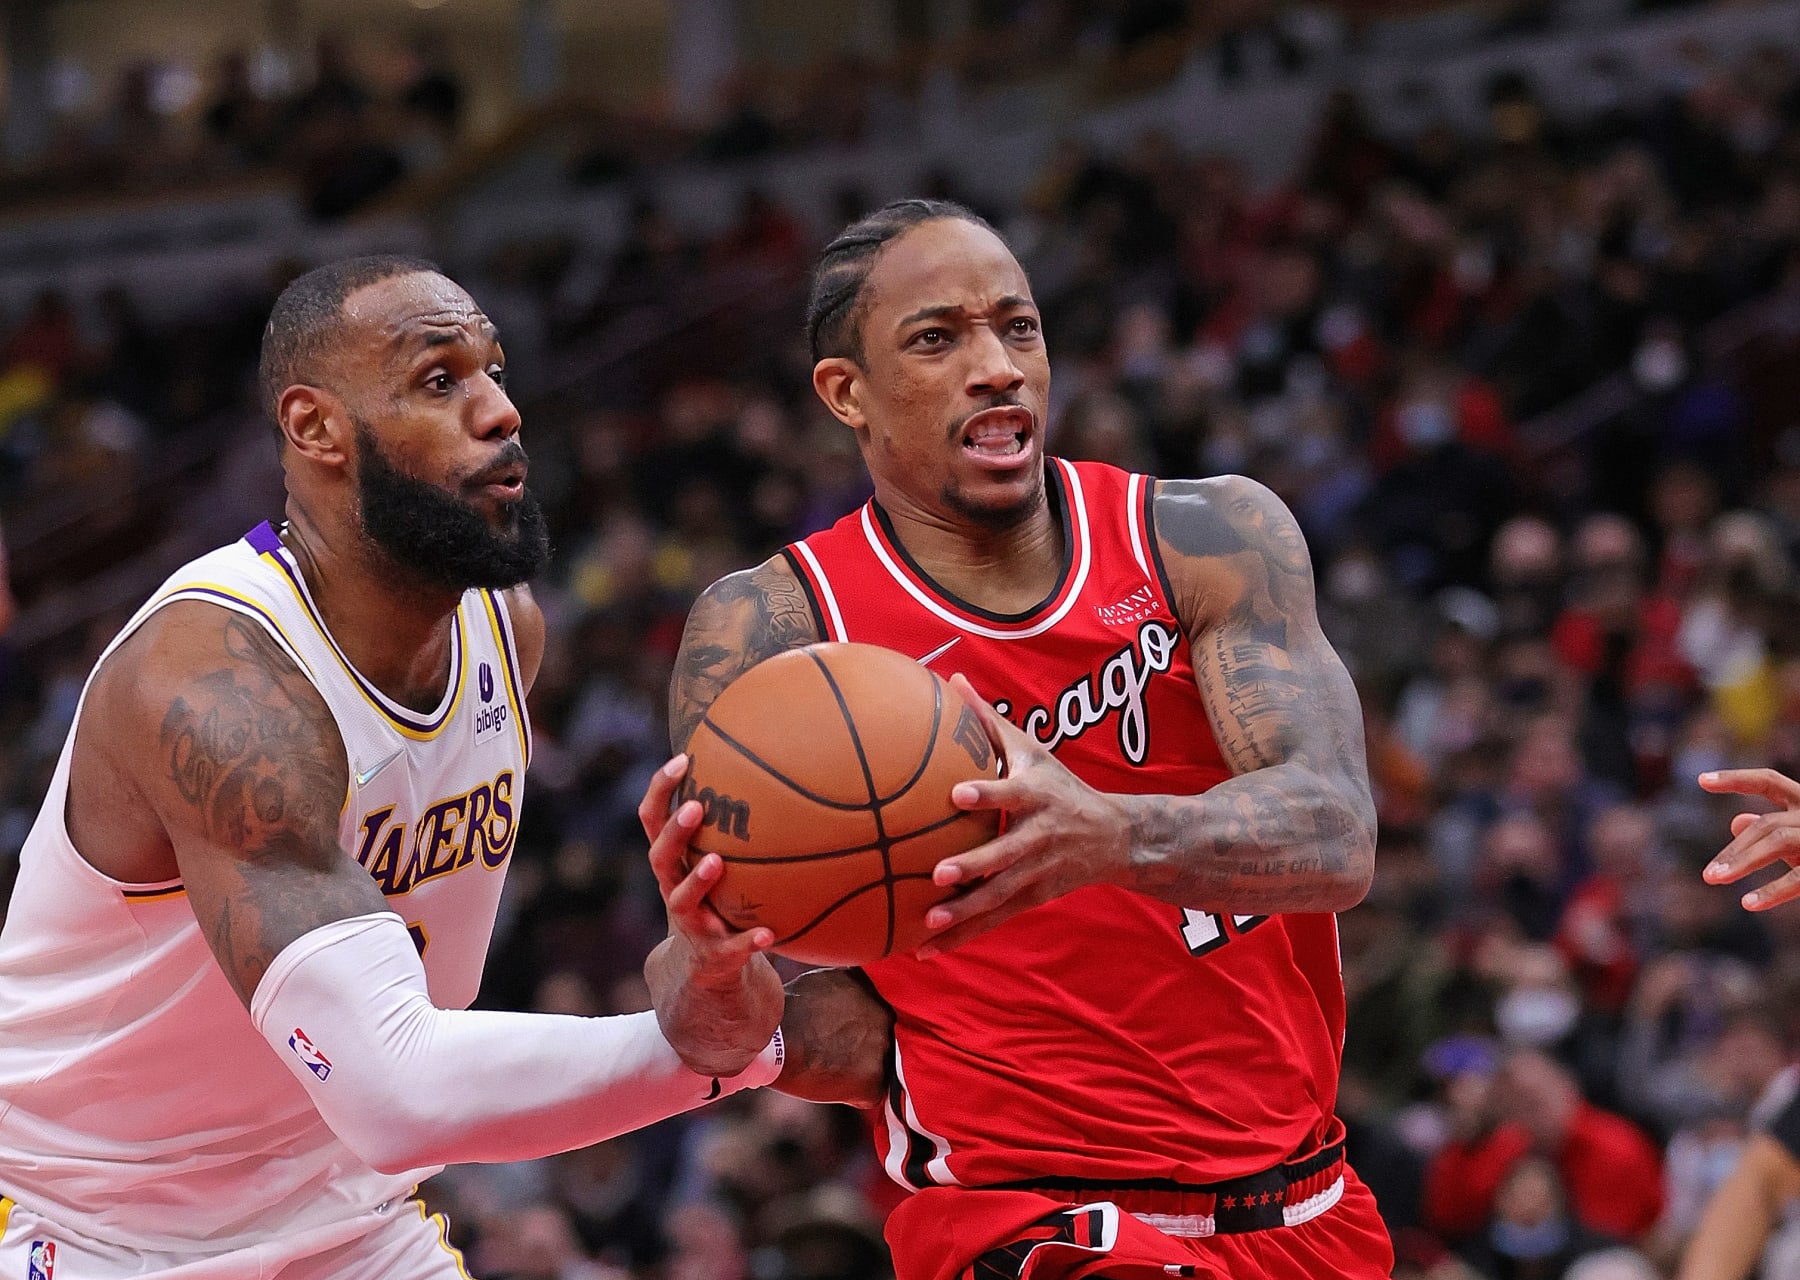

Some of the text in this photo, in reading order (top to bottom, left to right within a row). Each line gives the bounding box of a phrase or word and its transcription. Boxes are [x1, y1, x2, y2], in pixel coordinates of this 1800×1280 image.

[1103, 601, 1160, 626] EYEWEAR
[993, 620, 1181, 766] cago
[476, 704, 507, 735] bibigo
